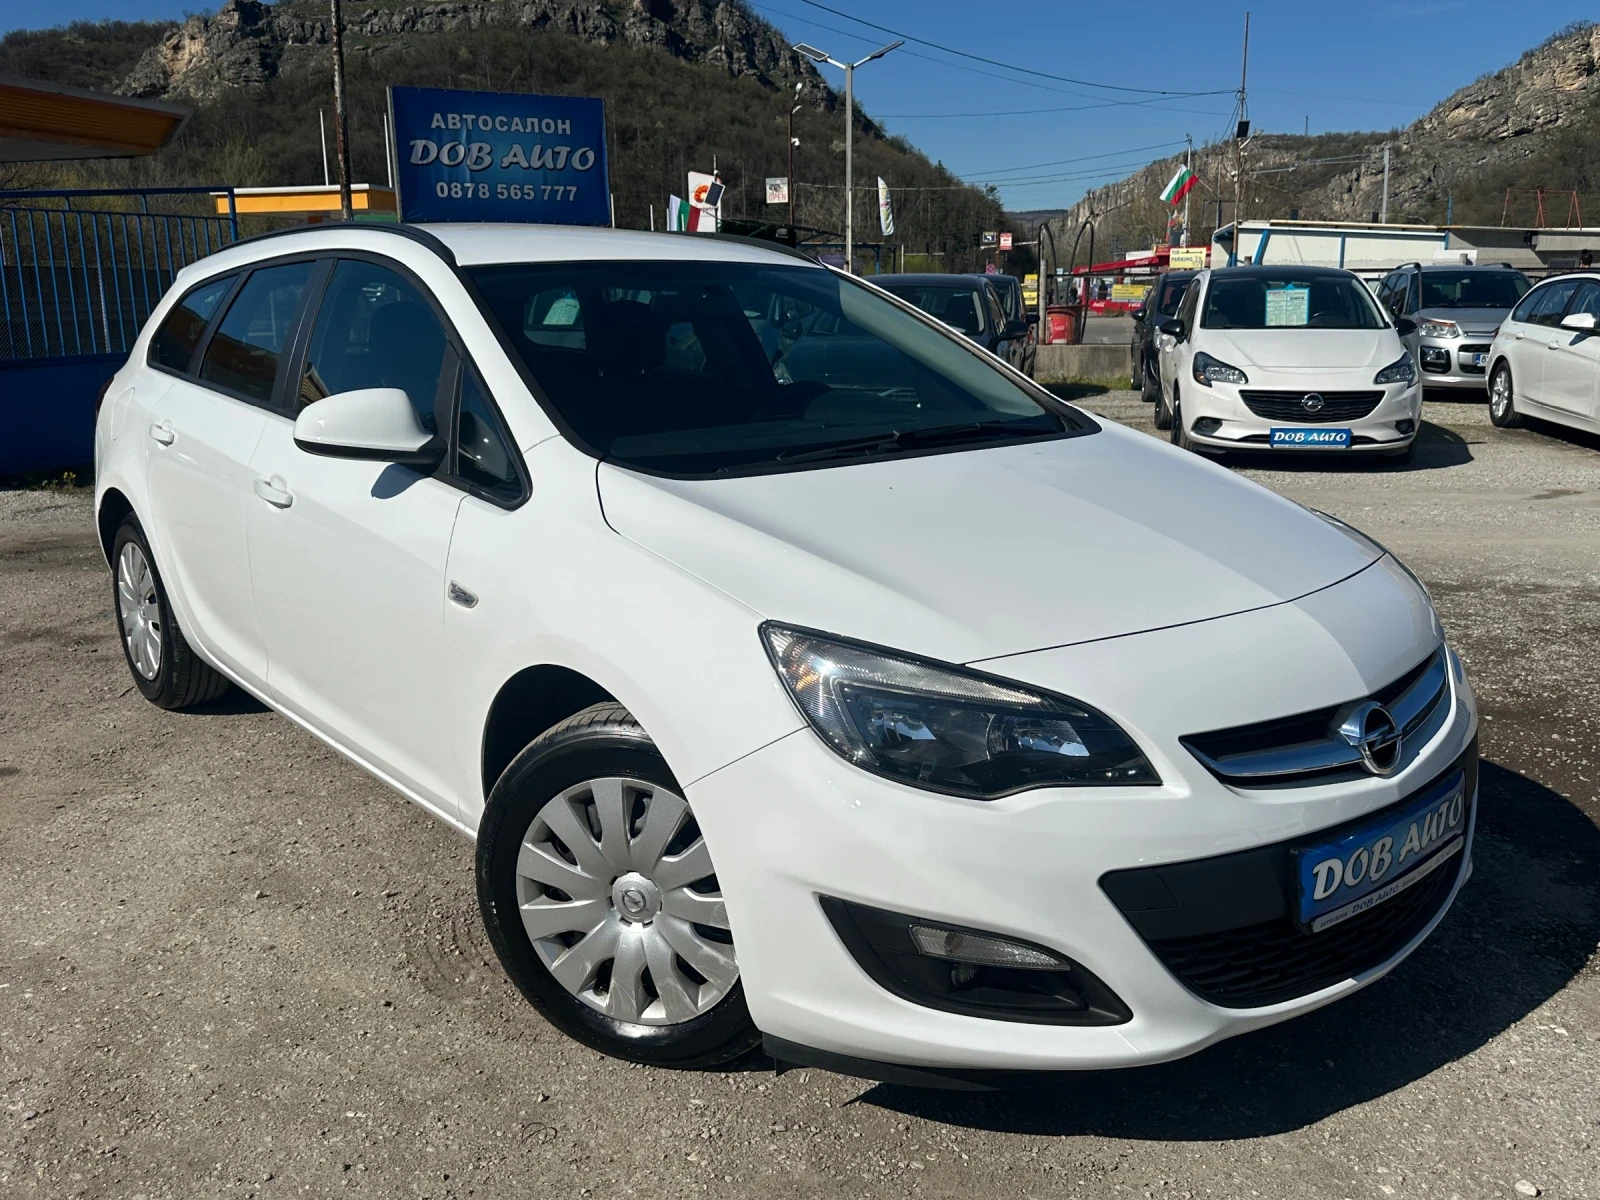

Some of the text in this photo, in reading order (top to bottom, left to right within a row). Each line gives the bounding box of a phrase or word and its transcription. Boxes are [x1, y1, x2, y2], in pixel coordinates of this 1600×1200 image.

[431, 113, 571, 135] АВТОСАЛОН
[409, 139, 596, 171] DOB AUTO
[436, 182, 578, 201] 0878 565 777
[768, 193, 787, 201] OPEN
[1273, 432, 1347, 443] DOB AUTO
[1312, 791, 1462, 900] DOB AUTO
[1352, 897, 1374, 914] DOB
